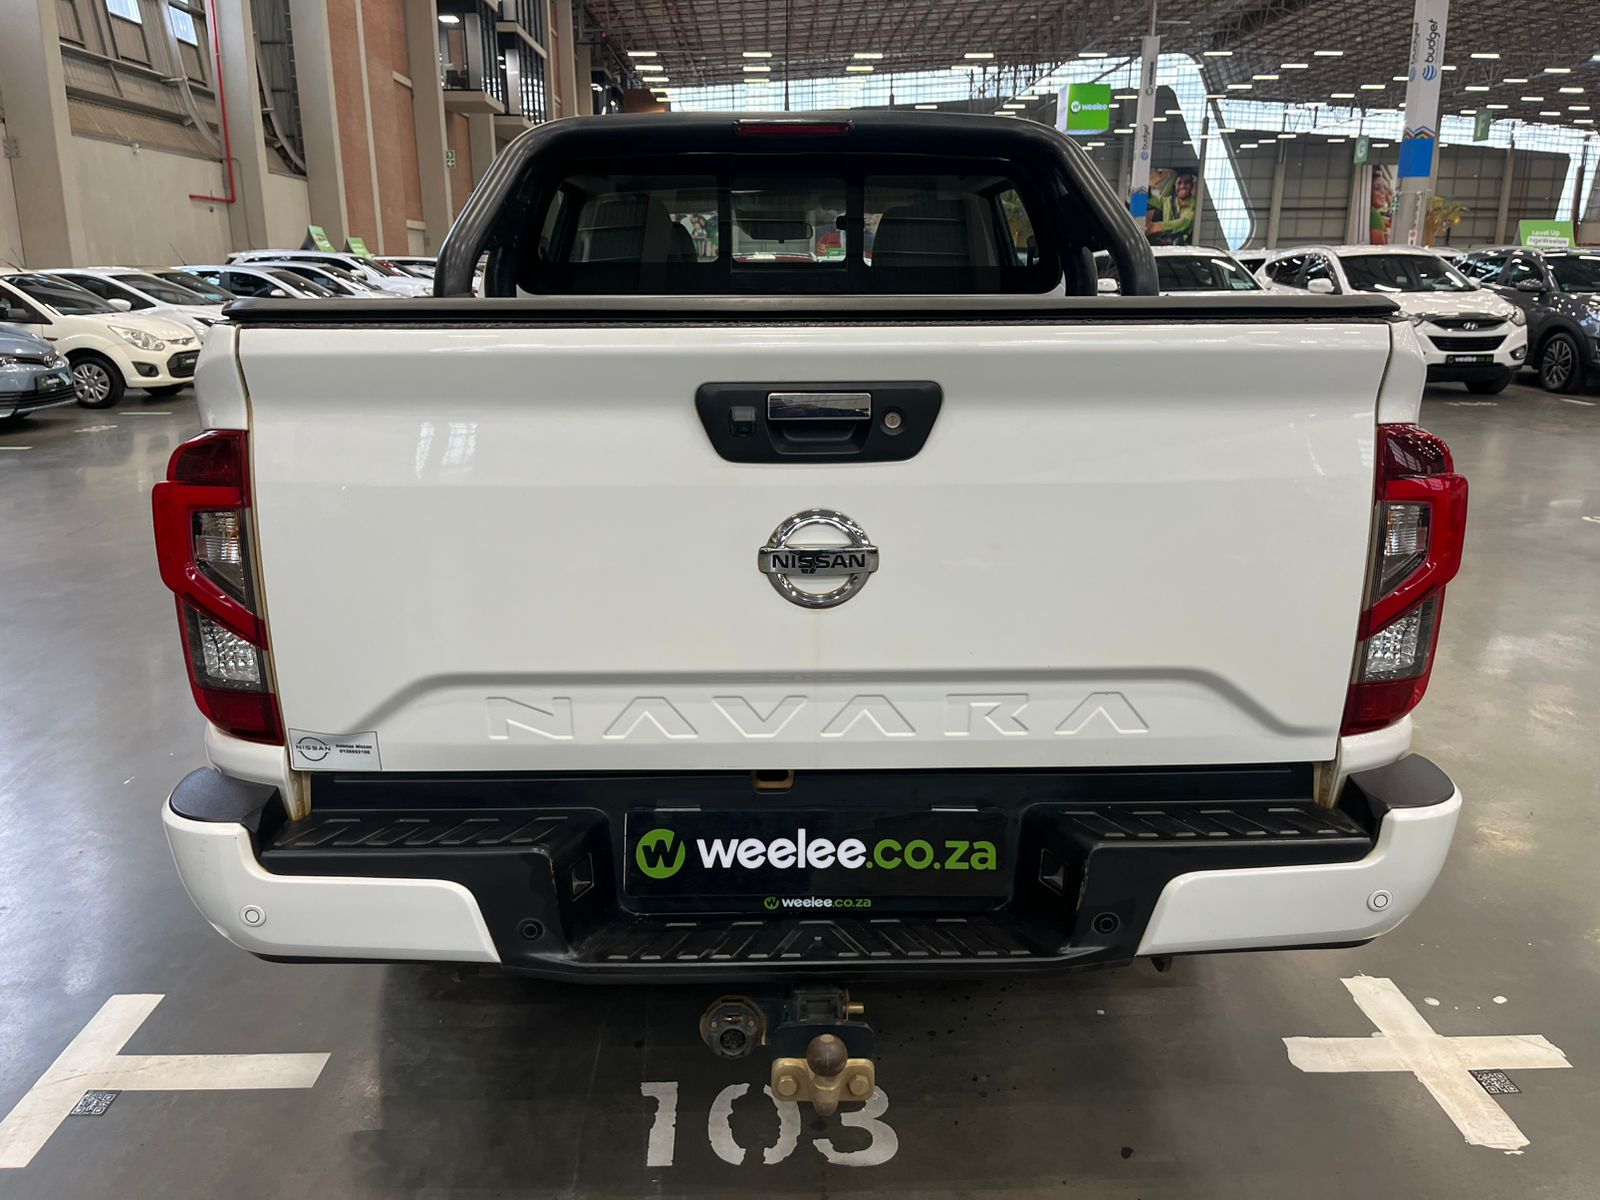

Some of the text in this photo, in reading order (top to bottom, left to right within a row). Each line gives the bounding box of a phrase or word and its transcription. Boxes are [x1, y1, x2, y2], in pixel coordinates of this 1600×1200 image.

[1424, 18, 1440, 63] budget
[772, 553, 866, 569] NISSAN
[486, 691, 1149, 738] NAVARA
[696, 828, 998, 870] weelee.co.za
[782, 896, 872, 908] weelee.co.za
[640, 1081, 899, 1167] 103
